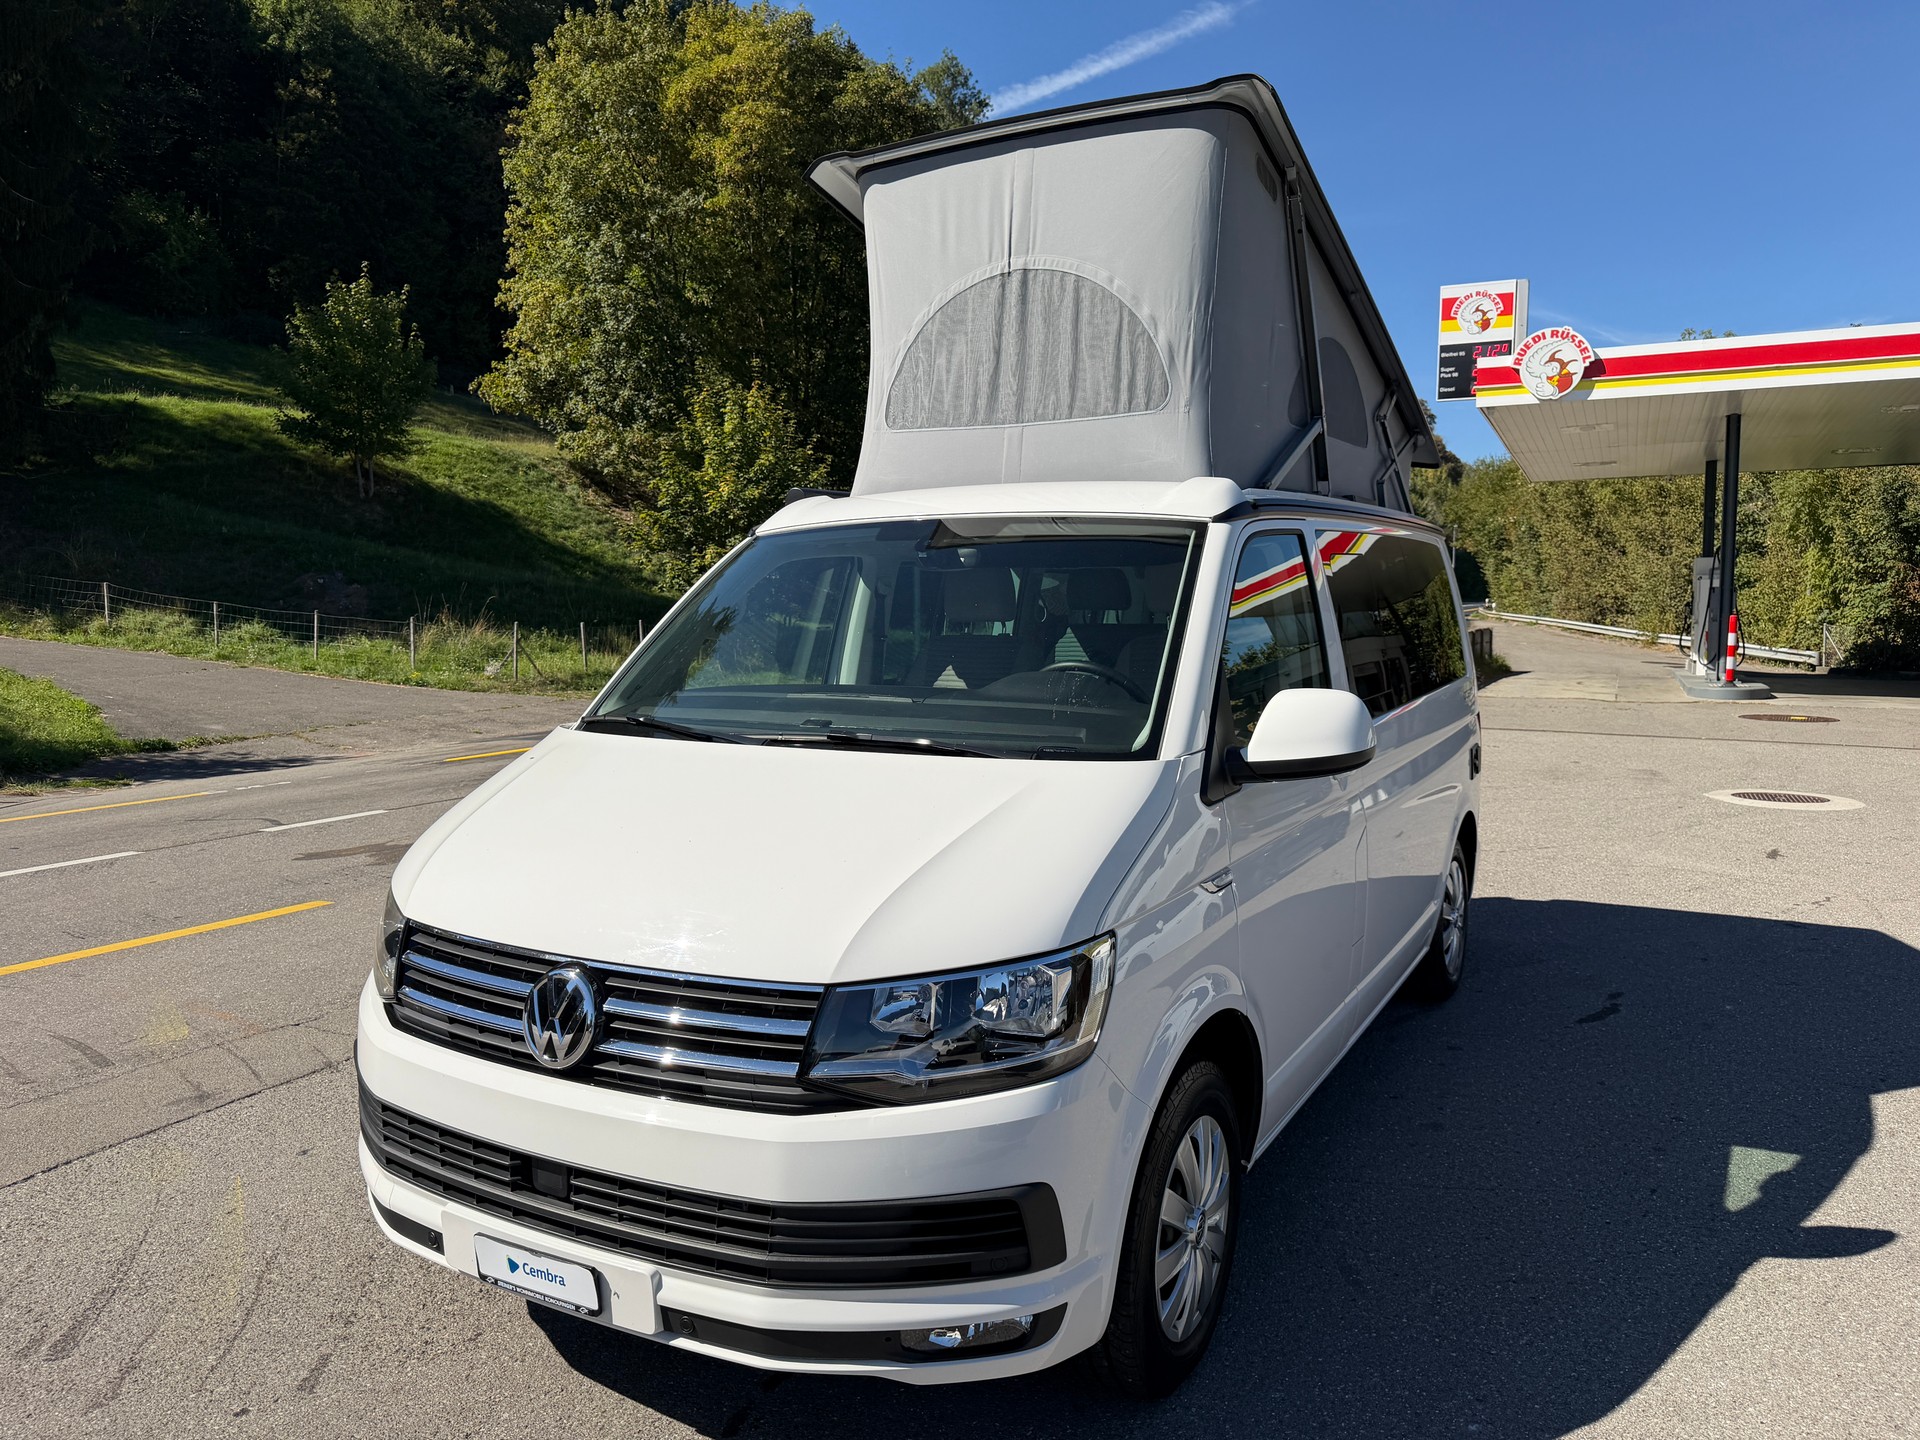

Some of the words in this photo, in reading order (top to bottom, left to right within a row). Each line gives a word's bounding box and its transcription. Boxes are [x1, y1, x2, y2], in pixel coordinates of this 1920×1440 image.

[1453, 293, 1473, 316] RUEDI
[1475, 290, 1504, 313] RÜSSEL
[1513, 331, 1547, 367] RUEDI
[1550, 328, 1593, 365] RÜSSEL
[522, 1262, 566, 1287] Cembra
